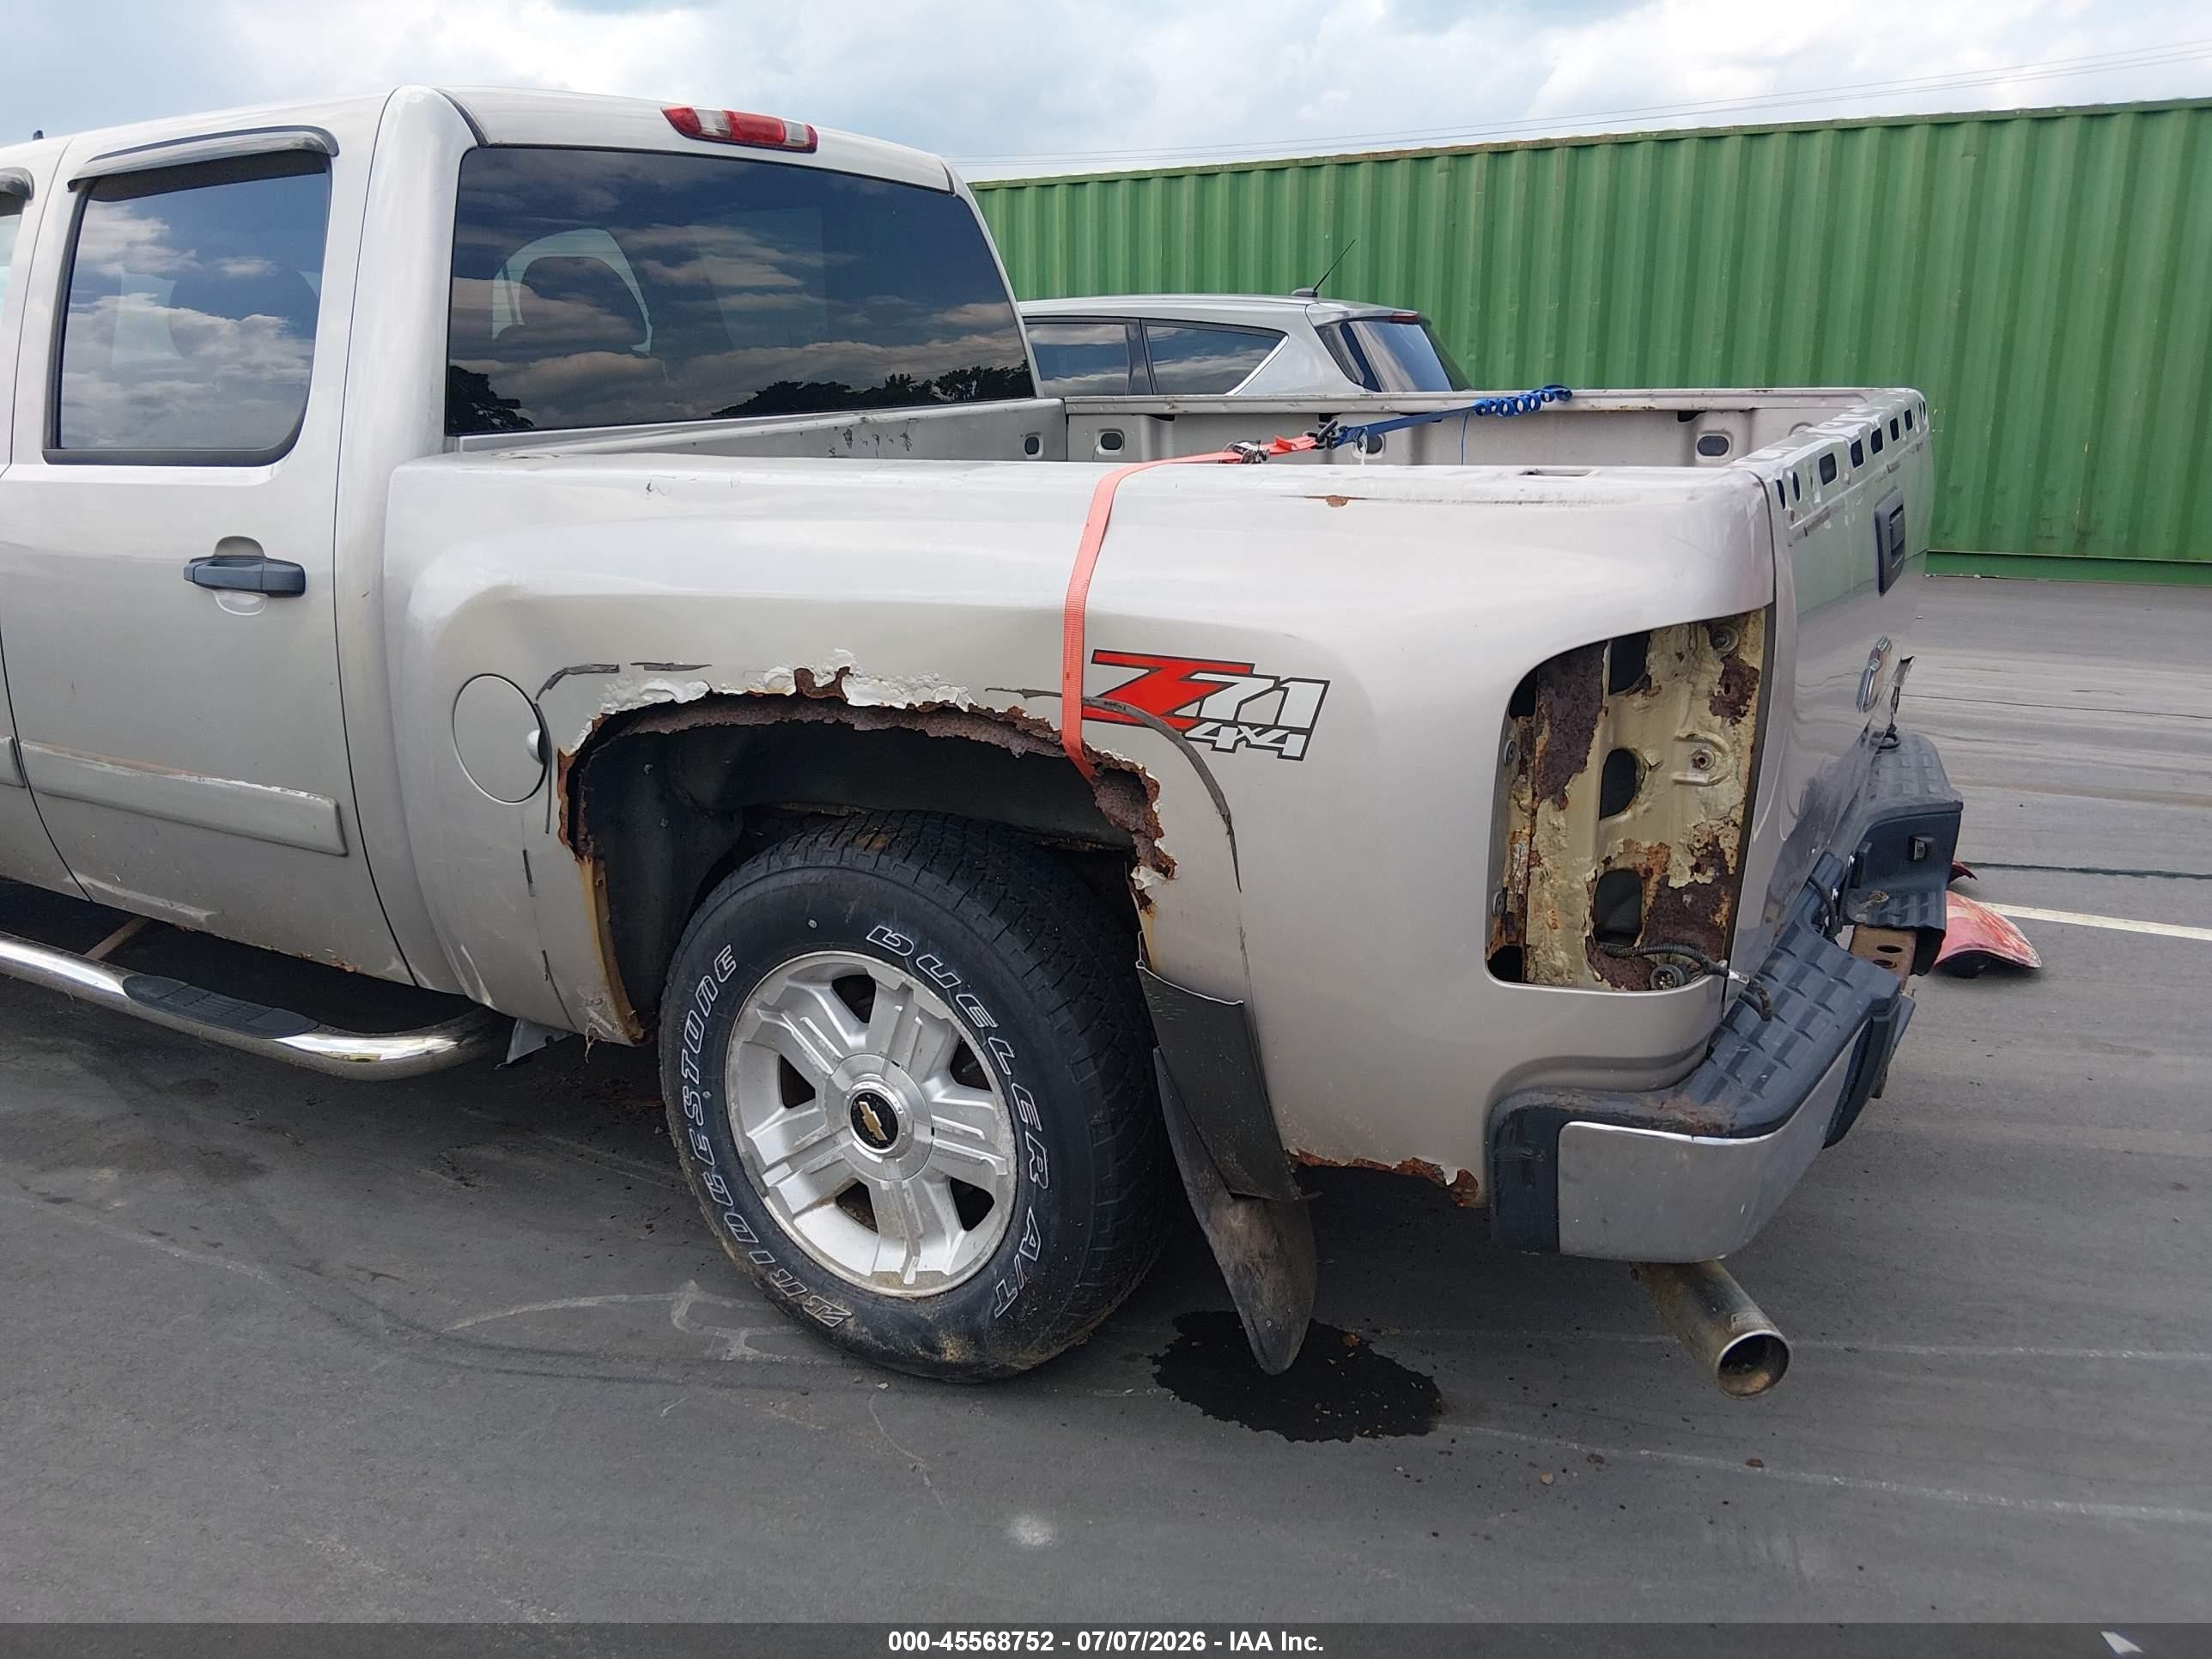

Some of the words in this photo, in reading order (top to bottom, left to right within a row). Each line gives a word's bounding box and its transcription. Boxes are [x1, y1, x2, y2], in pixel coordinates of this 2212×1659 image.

[1082, 649, 1330, 729] Z71
[681, 944, 853, 1328] BRIDGESTONE
[866, 925, 1048, 1189] DUELER
[994, 1206, 1042, 1319] A/T
